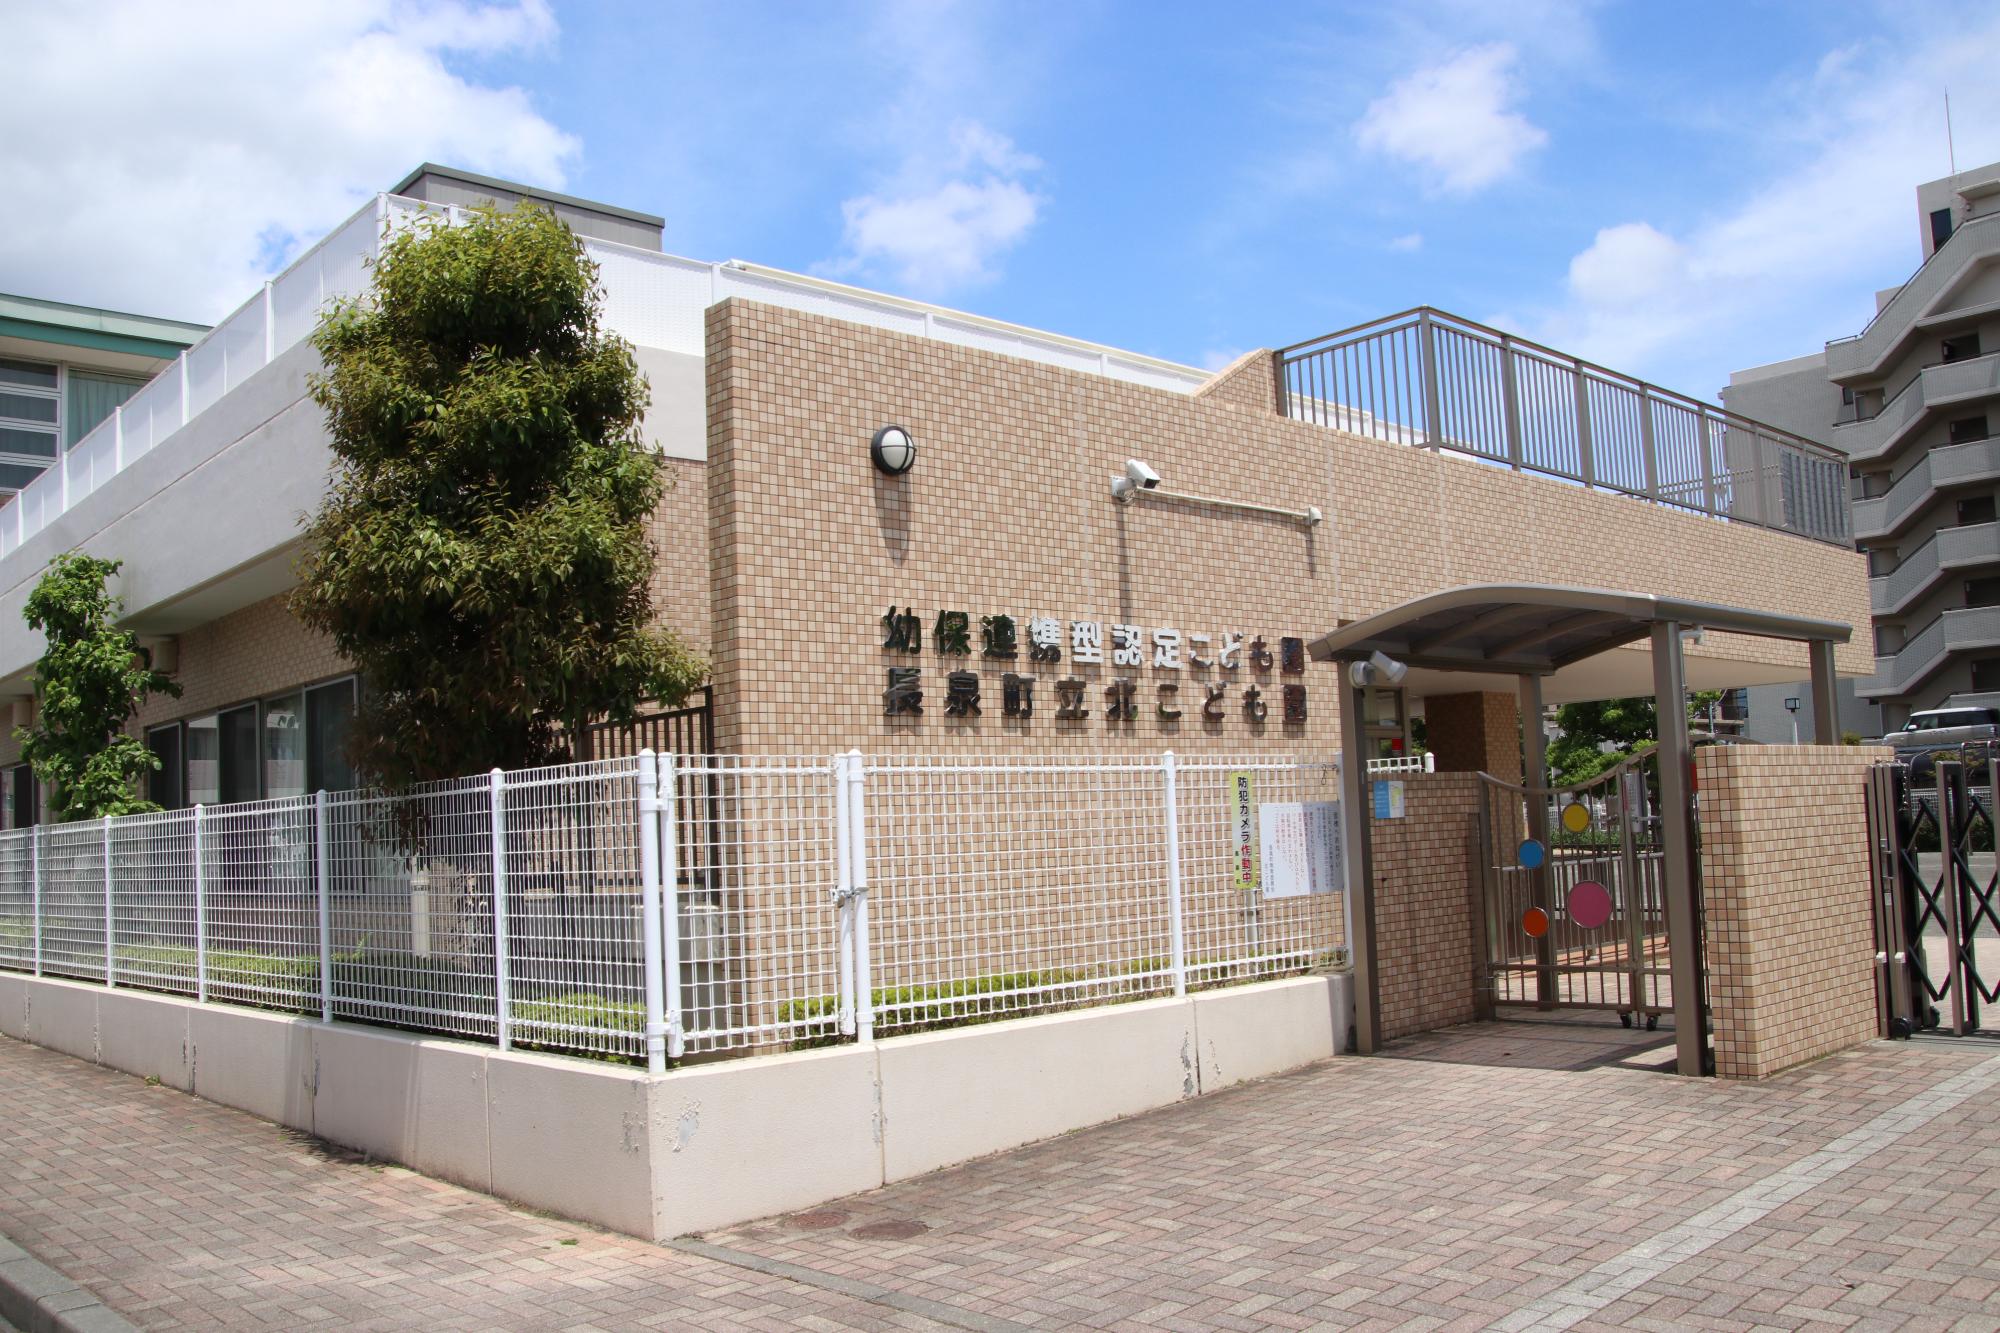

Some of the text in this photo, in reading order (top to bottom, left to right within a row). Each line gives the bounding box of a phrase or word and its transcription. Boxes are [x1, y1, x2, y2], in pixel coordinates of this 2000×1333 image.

[1237, 776, 1253, 884] 防犯カメラ作動中
